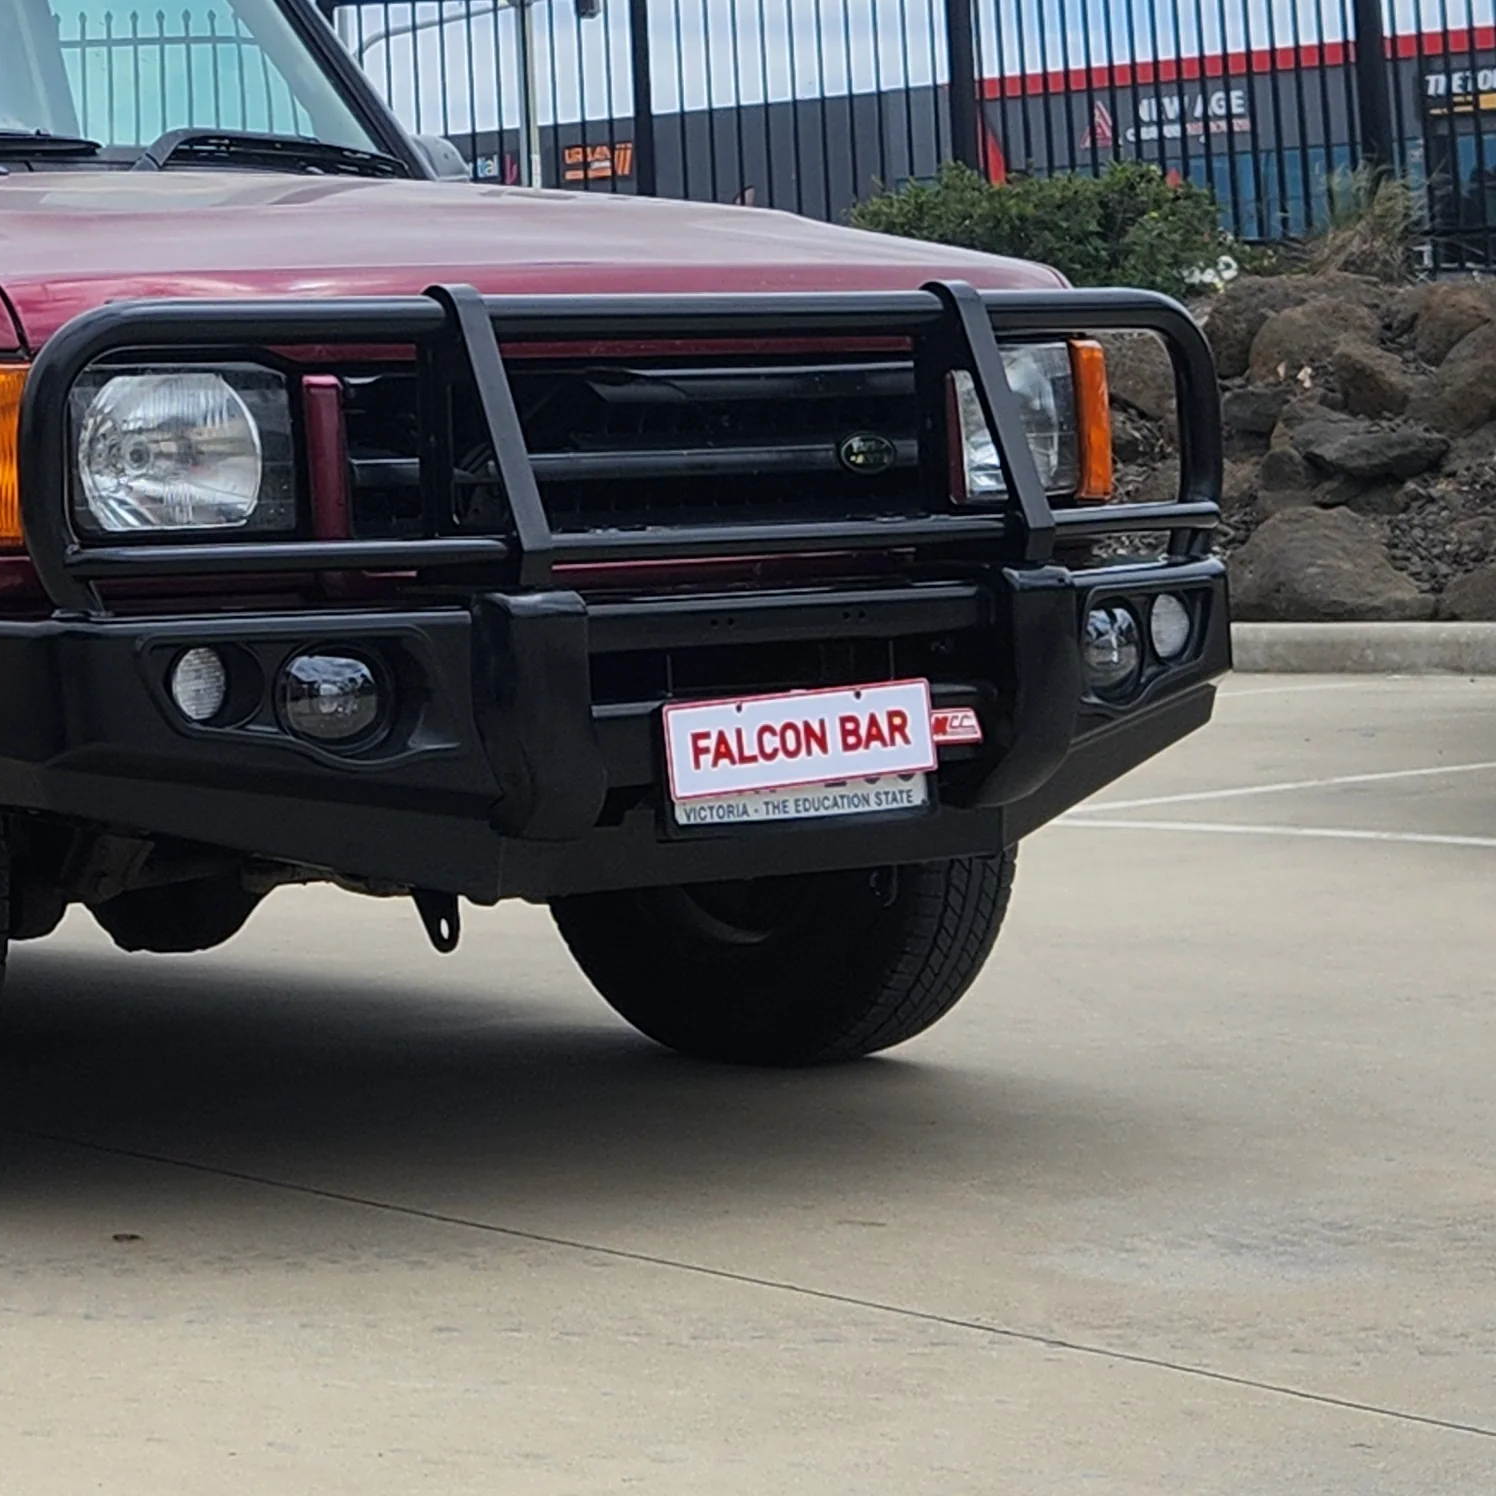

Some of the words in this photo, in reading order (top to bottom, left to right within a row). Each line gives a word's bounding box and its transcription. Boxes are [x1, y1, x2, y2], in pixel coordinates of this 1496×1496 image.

[690, 718, 829, 771] FALCON
[839, 709, 913, 752] BAR
[682, 804, 750, 823] VICTORIA
[763, 799, 790, 816] THE
[793, 792, 871, 813] EDUCATION
[874, 789, 914, 805] STATE
